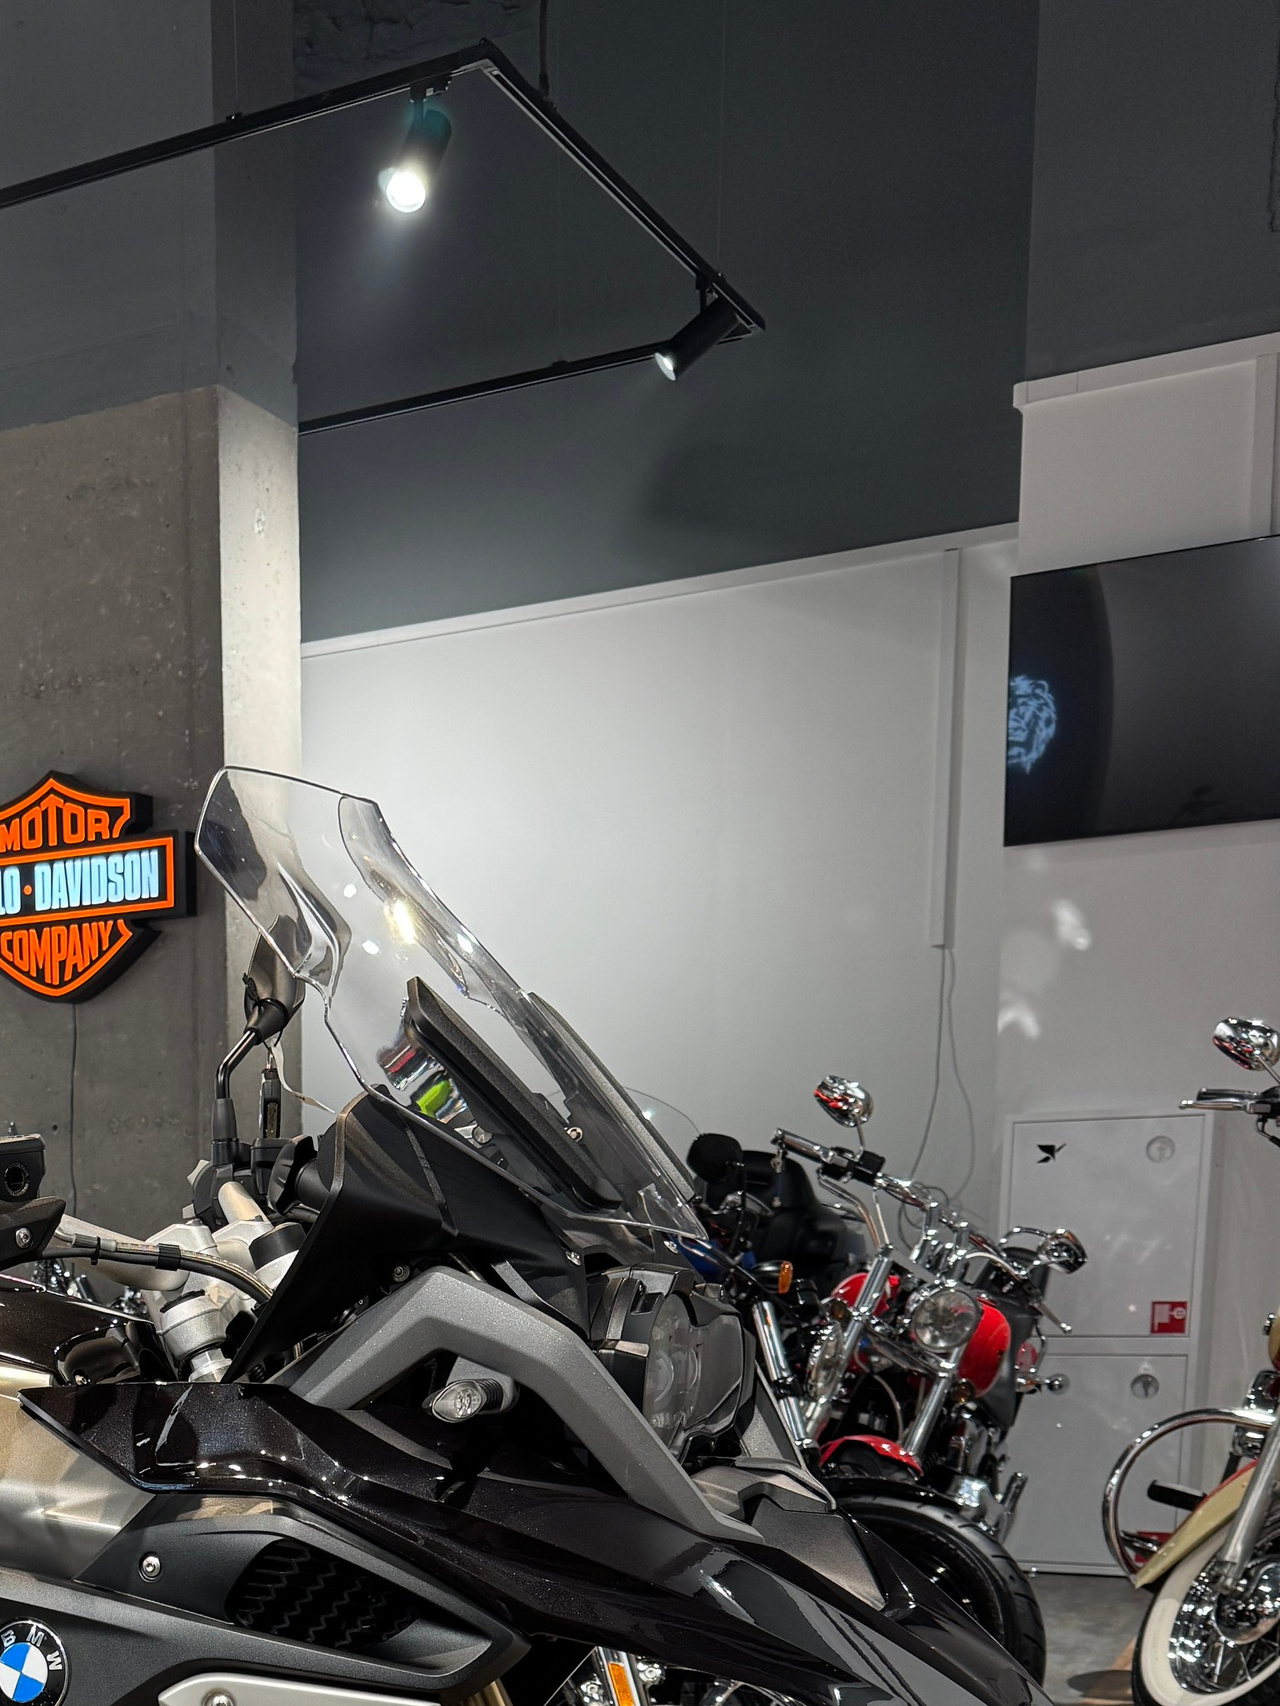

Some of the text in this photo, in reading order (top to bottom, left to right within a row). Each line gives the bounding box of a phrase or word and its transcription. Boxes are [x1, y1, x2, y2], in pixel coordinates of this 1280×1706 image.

[33, 848, 160, 912] DAVIDSON
[0, 918, 114, 986] COMPANY
[0, 1623, 64, 1671] BMW
